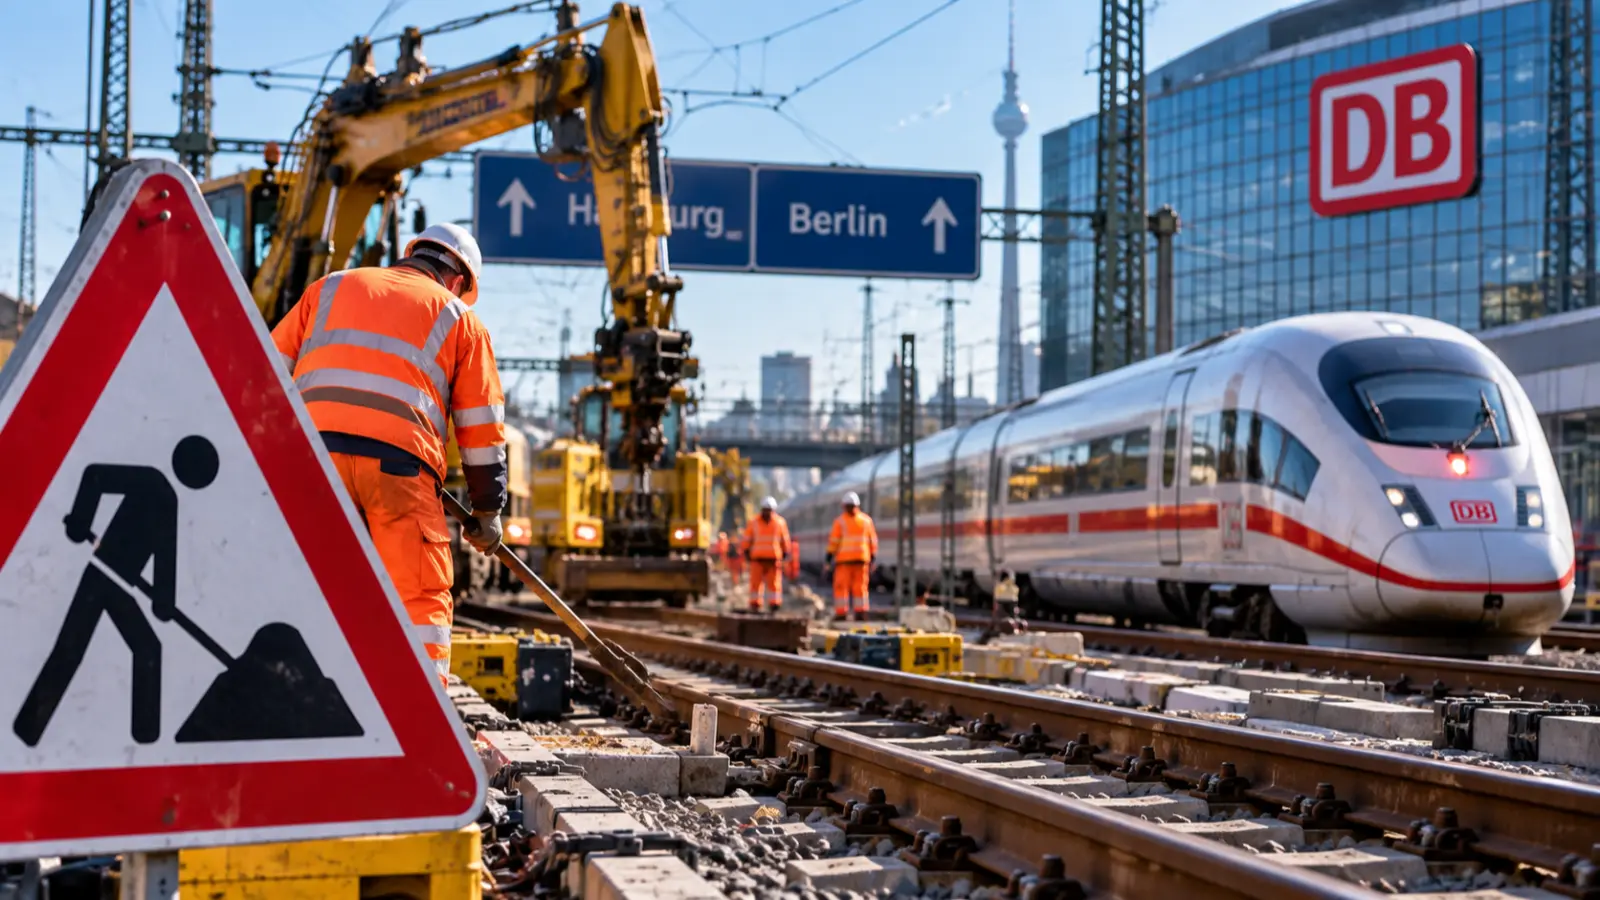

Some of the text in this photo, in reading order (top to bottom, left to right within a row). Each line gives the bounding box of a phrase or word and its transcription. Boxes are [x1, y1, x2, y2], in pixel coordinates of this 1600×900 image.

[1332, 77, 1452, 188] DB
[568, 192, 724, 239] Hurg
[789, 202, 888, 237] Berlin
[1458, 503, 1491, 519] DB
